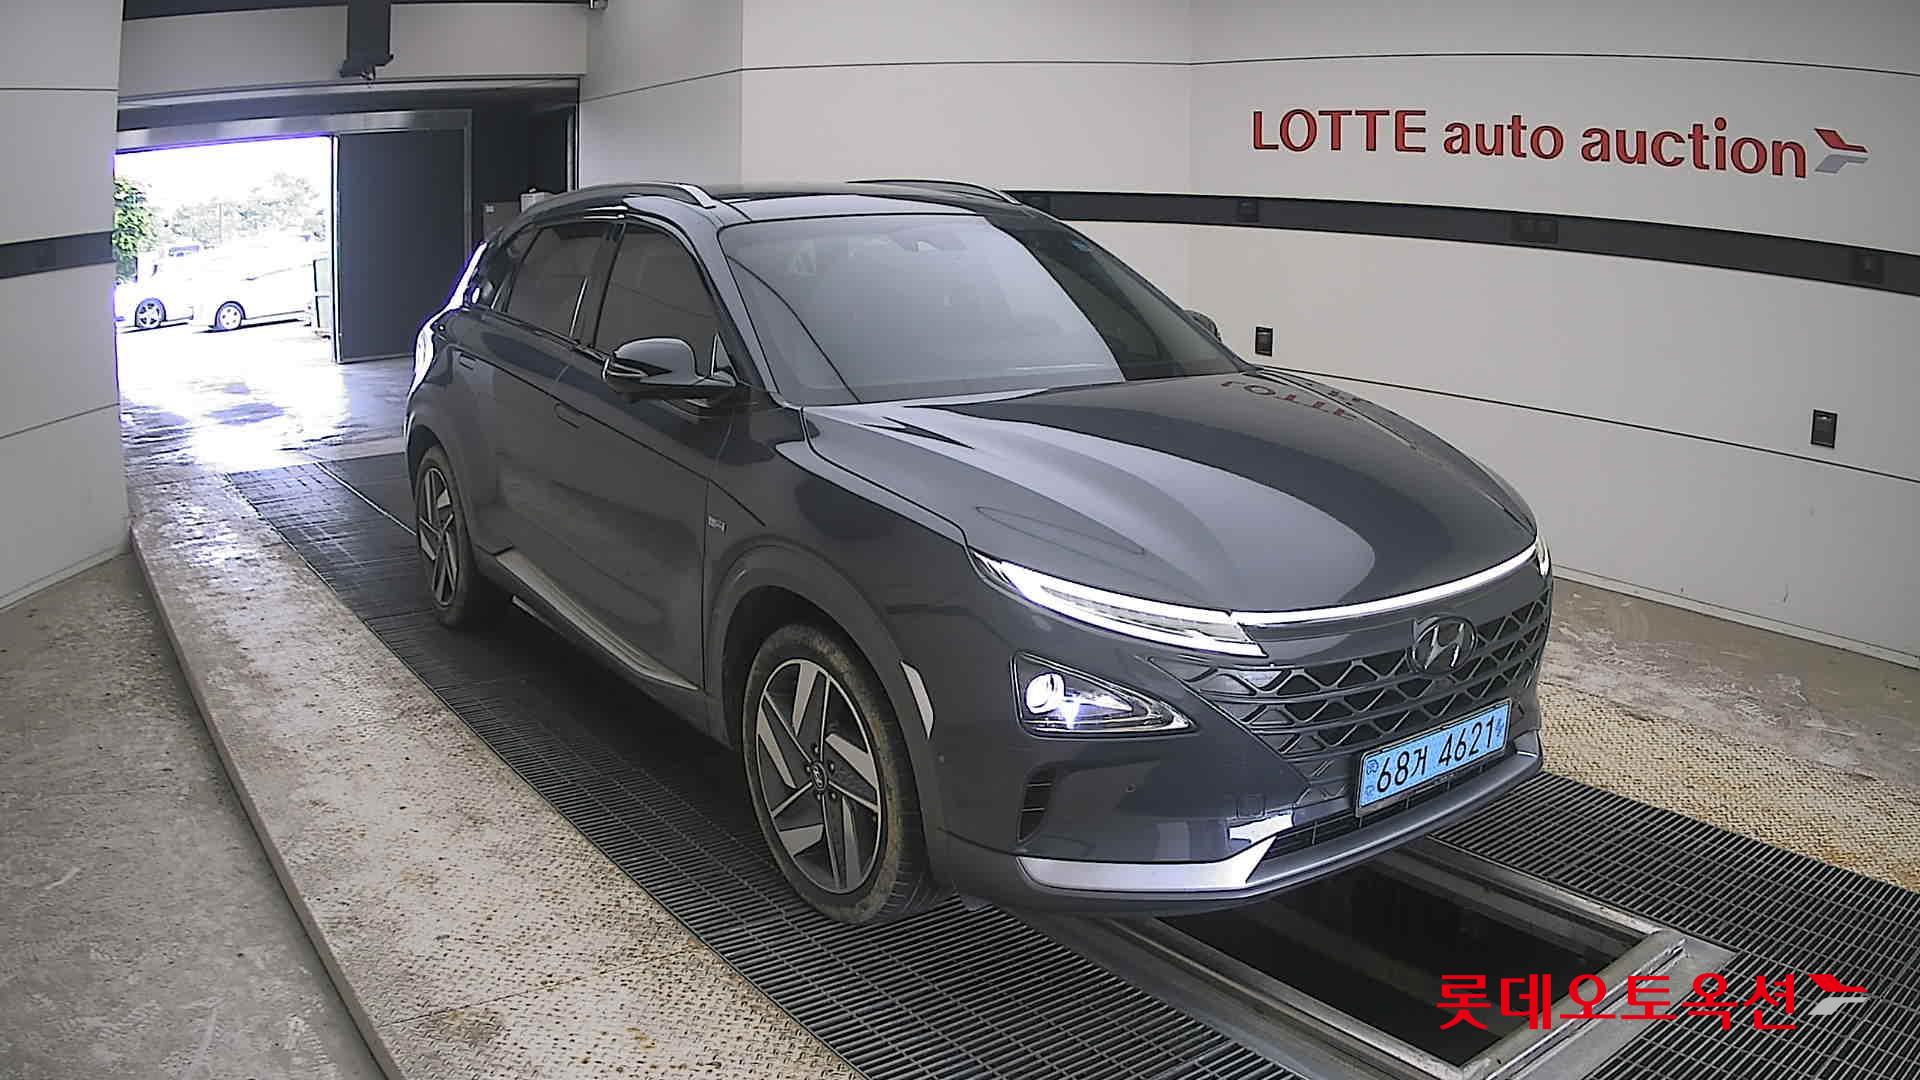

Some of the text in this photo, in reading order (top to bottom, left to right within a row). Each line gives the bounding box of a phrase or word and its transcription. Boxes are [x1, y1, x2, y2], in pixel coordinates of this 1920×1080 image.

[1253, 109, 1808, 179] LOTTE auto auction
[1376, 716, 1495, 793] 68거 4621
